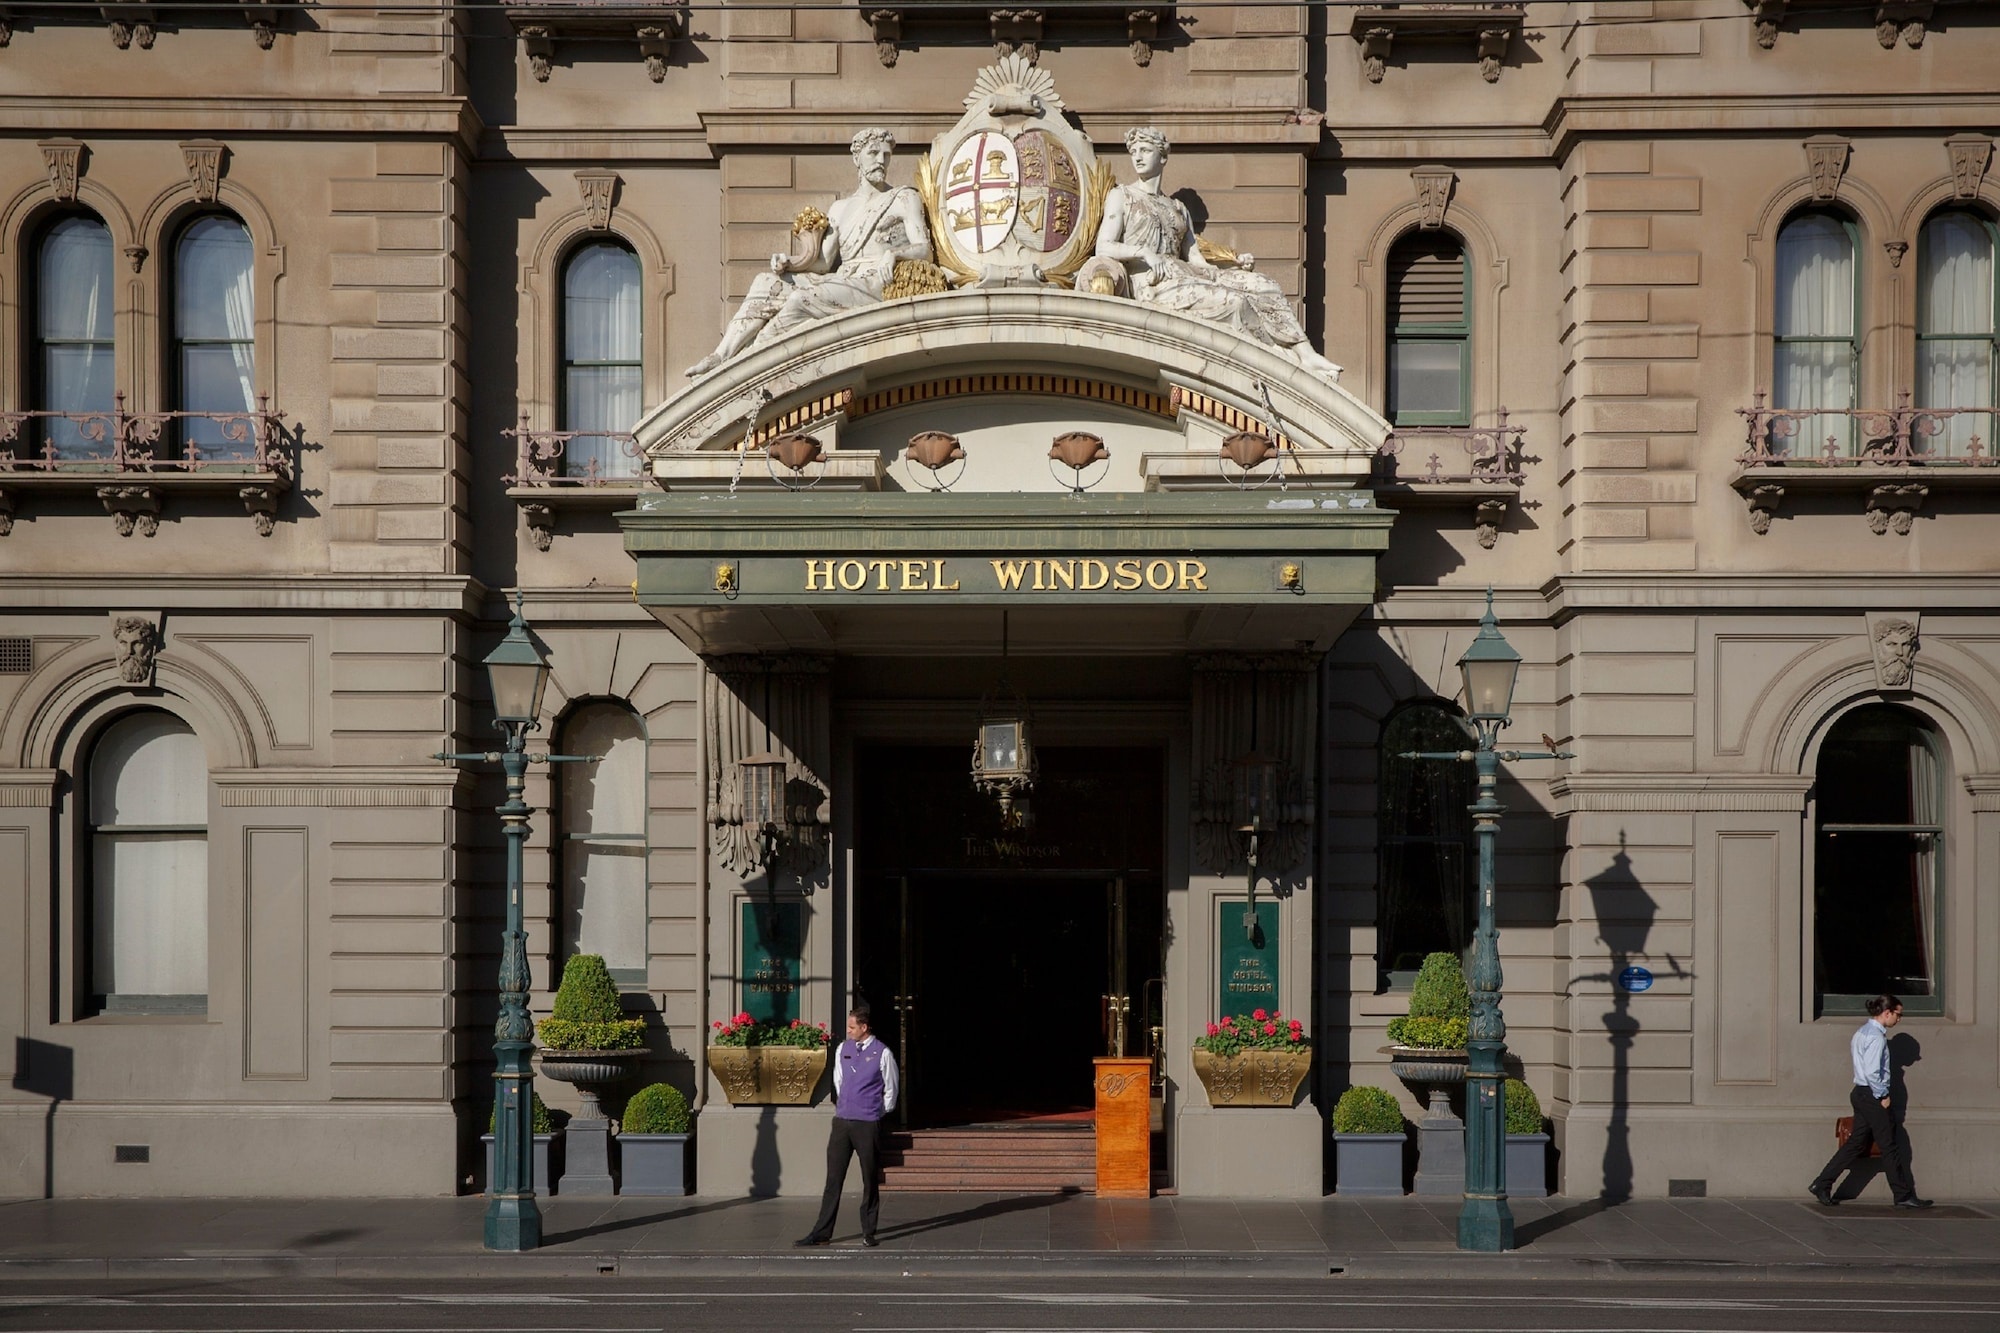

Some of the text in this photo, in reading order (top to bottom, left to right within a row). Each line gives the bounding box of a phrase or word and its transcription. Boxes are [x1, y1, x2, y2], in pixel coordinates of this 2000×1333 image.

[804, 559, 1209, 591] HOTEL WINDSOR
[1233, 970, 1268, 980] HOTEL
[750, 983, 794, 993] WINDSOR
[1228, 983, 1273, 993] WINDSOR
